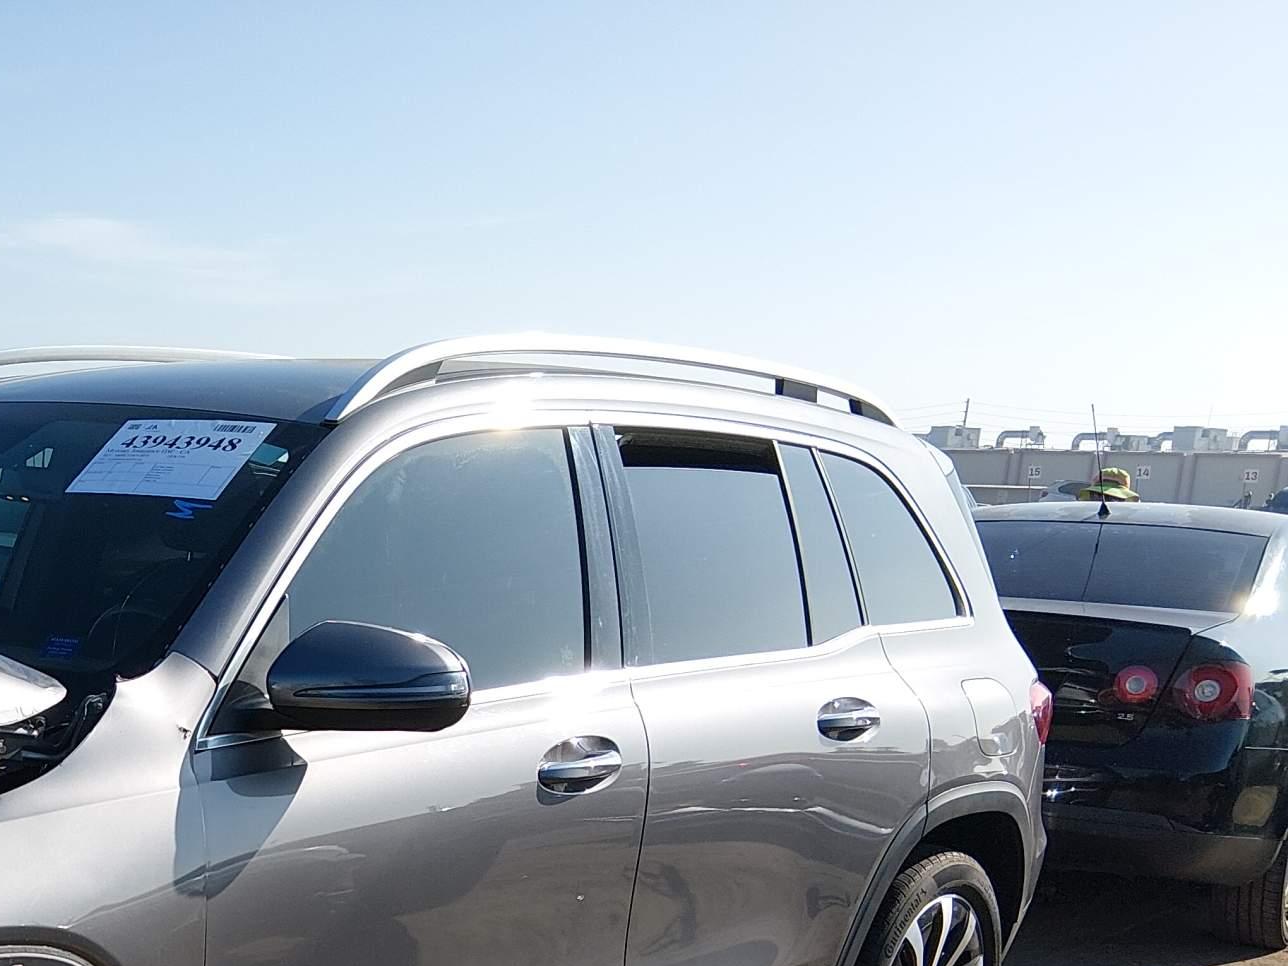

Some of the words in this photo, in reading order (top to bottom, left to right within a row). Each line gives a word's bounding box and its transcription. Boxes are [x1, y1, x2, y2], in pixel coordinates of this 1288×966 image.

[120, 434, 242, 453] 43943948
[1029, 467, 1041, 477] 15
[1136, 467, 1150, 477] 14
[1244, 471, 1258, 481] 13
[884, 895, 922, 958] Continental
